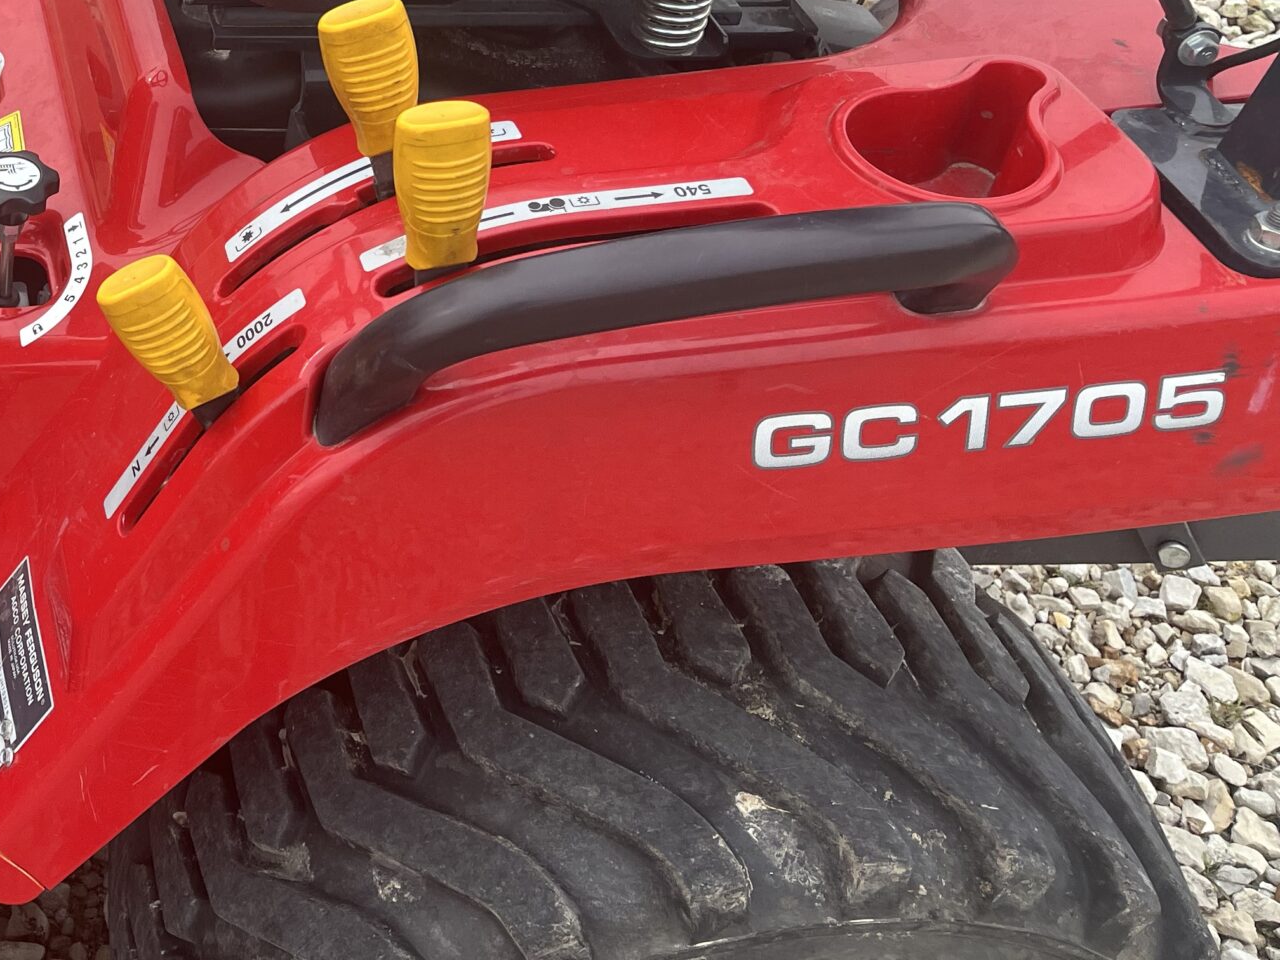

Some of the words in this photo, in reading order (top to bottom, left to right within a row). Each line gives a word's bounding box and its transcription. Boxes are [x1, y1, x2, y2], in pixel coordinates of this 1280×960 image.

[673, 183, 712, 198] 540
[75, 248, 87, 259] 2
[76, 262, 88, 272] 3
[74, 276, 85, 285] 4
[64, 294, 75, 303] 5
[236, 312, 273, 349] 2000
[752, 403, 918, 470] GC
[937, 368, 1227, 452] 1705
[131, 459, 141, 478] N
[17, 573, 31, 626] MASSEY
[10, 595, 20, 625] AGCO
[14, 627, 34, 706] CORPORATION
